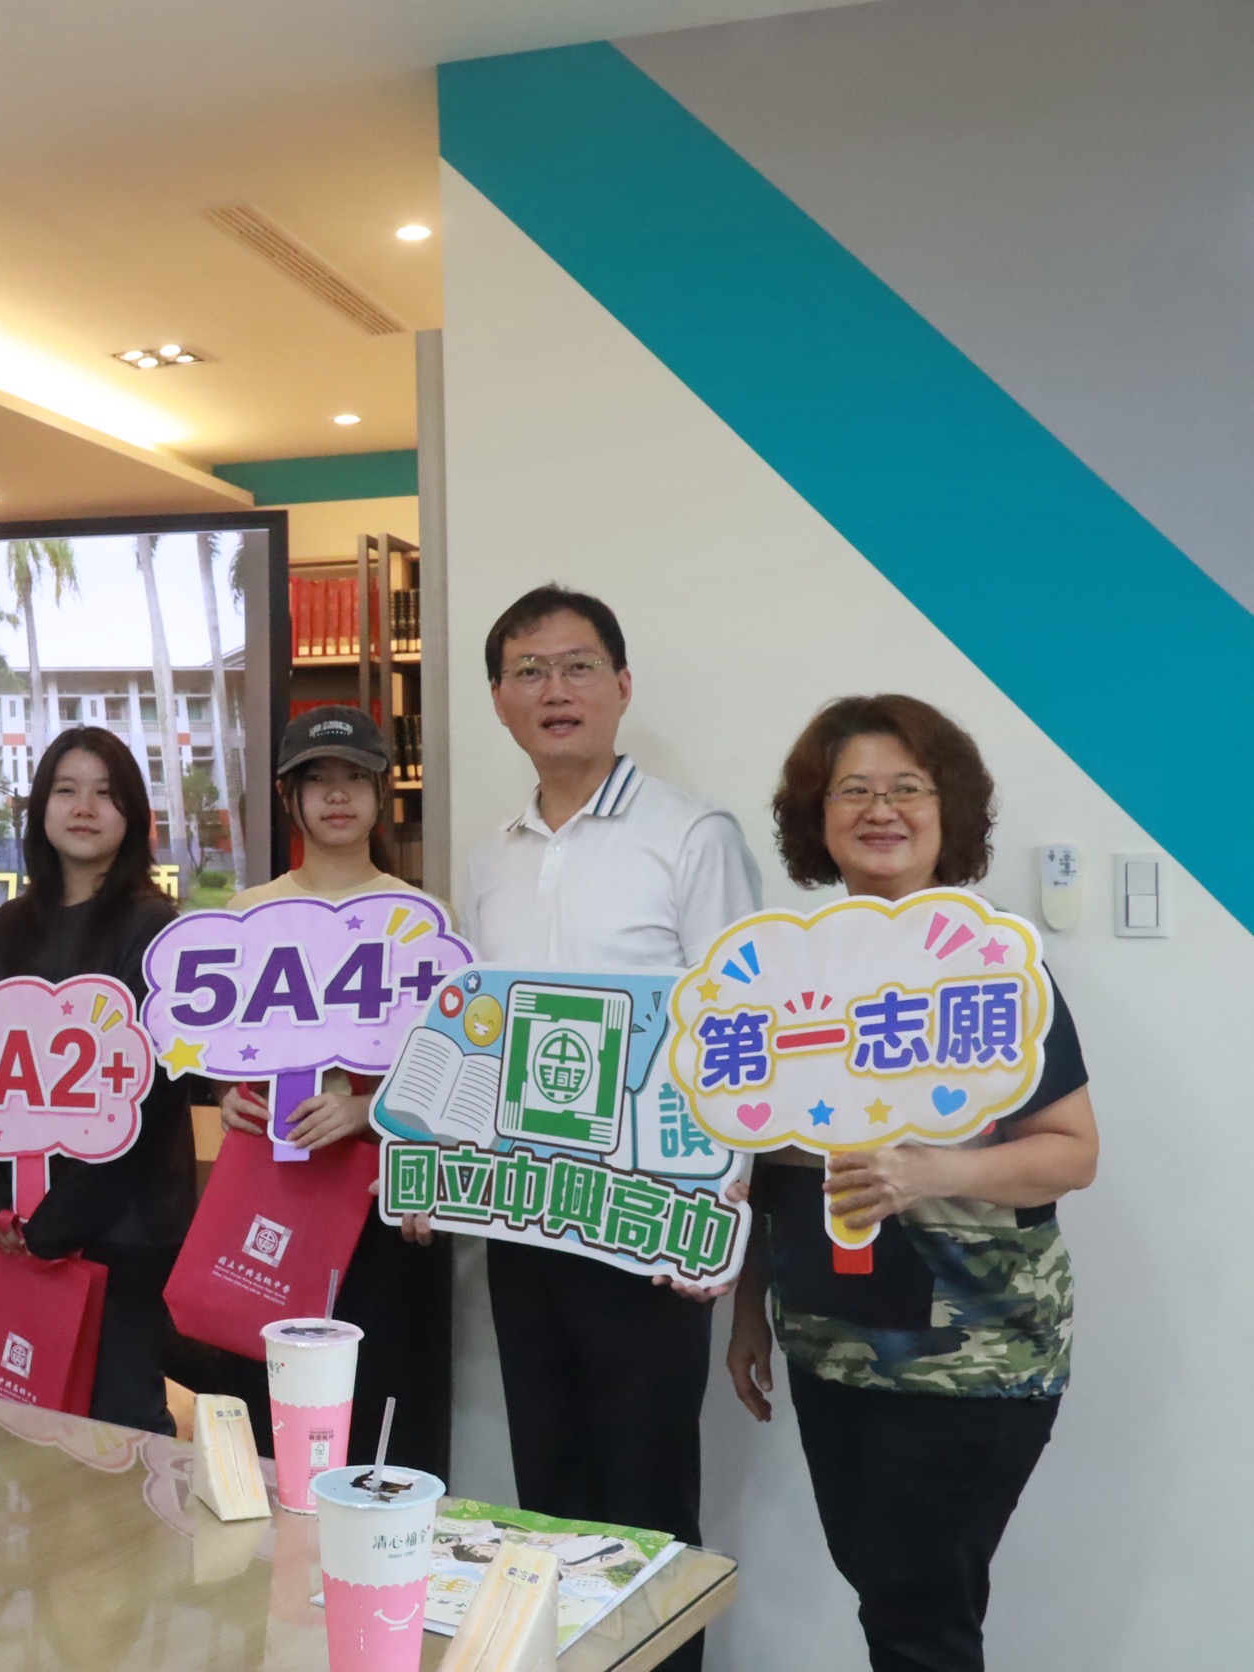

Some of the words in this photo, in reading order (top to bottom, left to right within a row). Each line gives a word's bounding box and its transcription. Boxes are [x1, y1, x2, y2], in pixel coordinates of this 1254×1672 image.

[170, 943, 449, 1027] 5A4+
[699, 982, 1018, 1088] 第一志願
[388, 1146, 734, 1273] 國立中興高中
[372, 1529, 427, 1549] 清心福全
